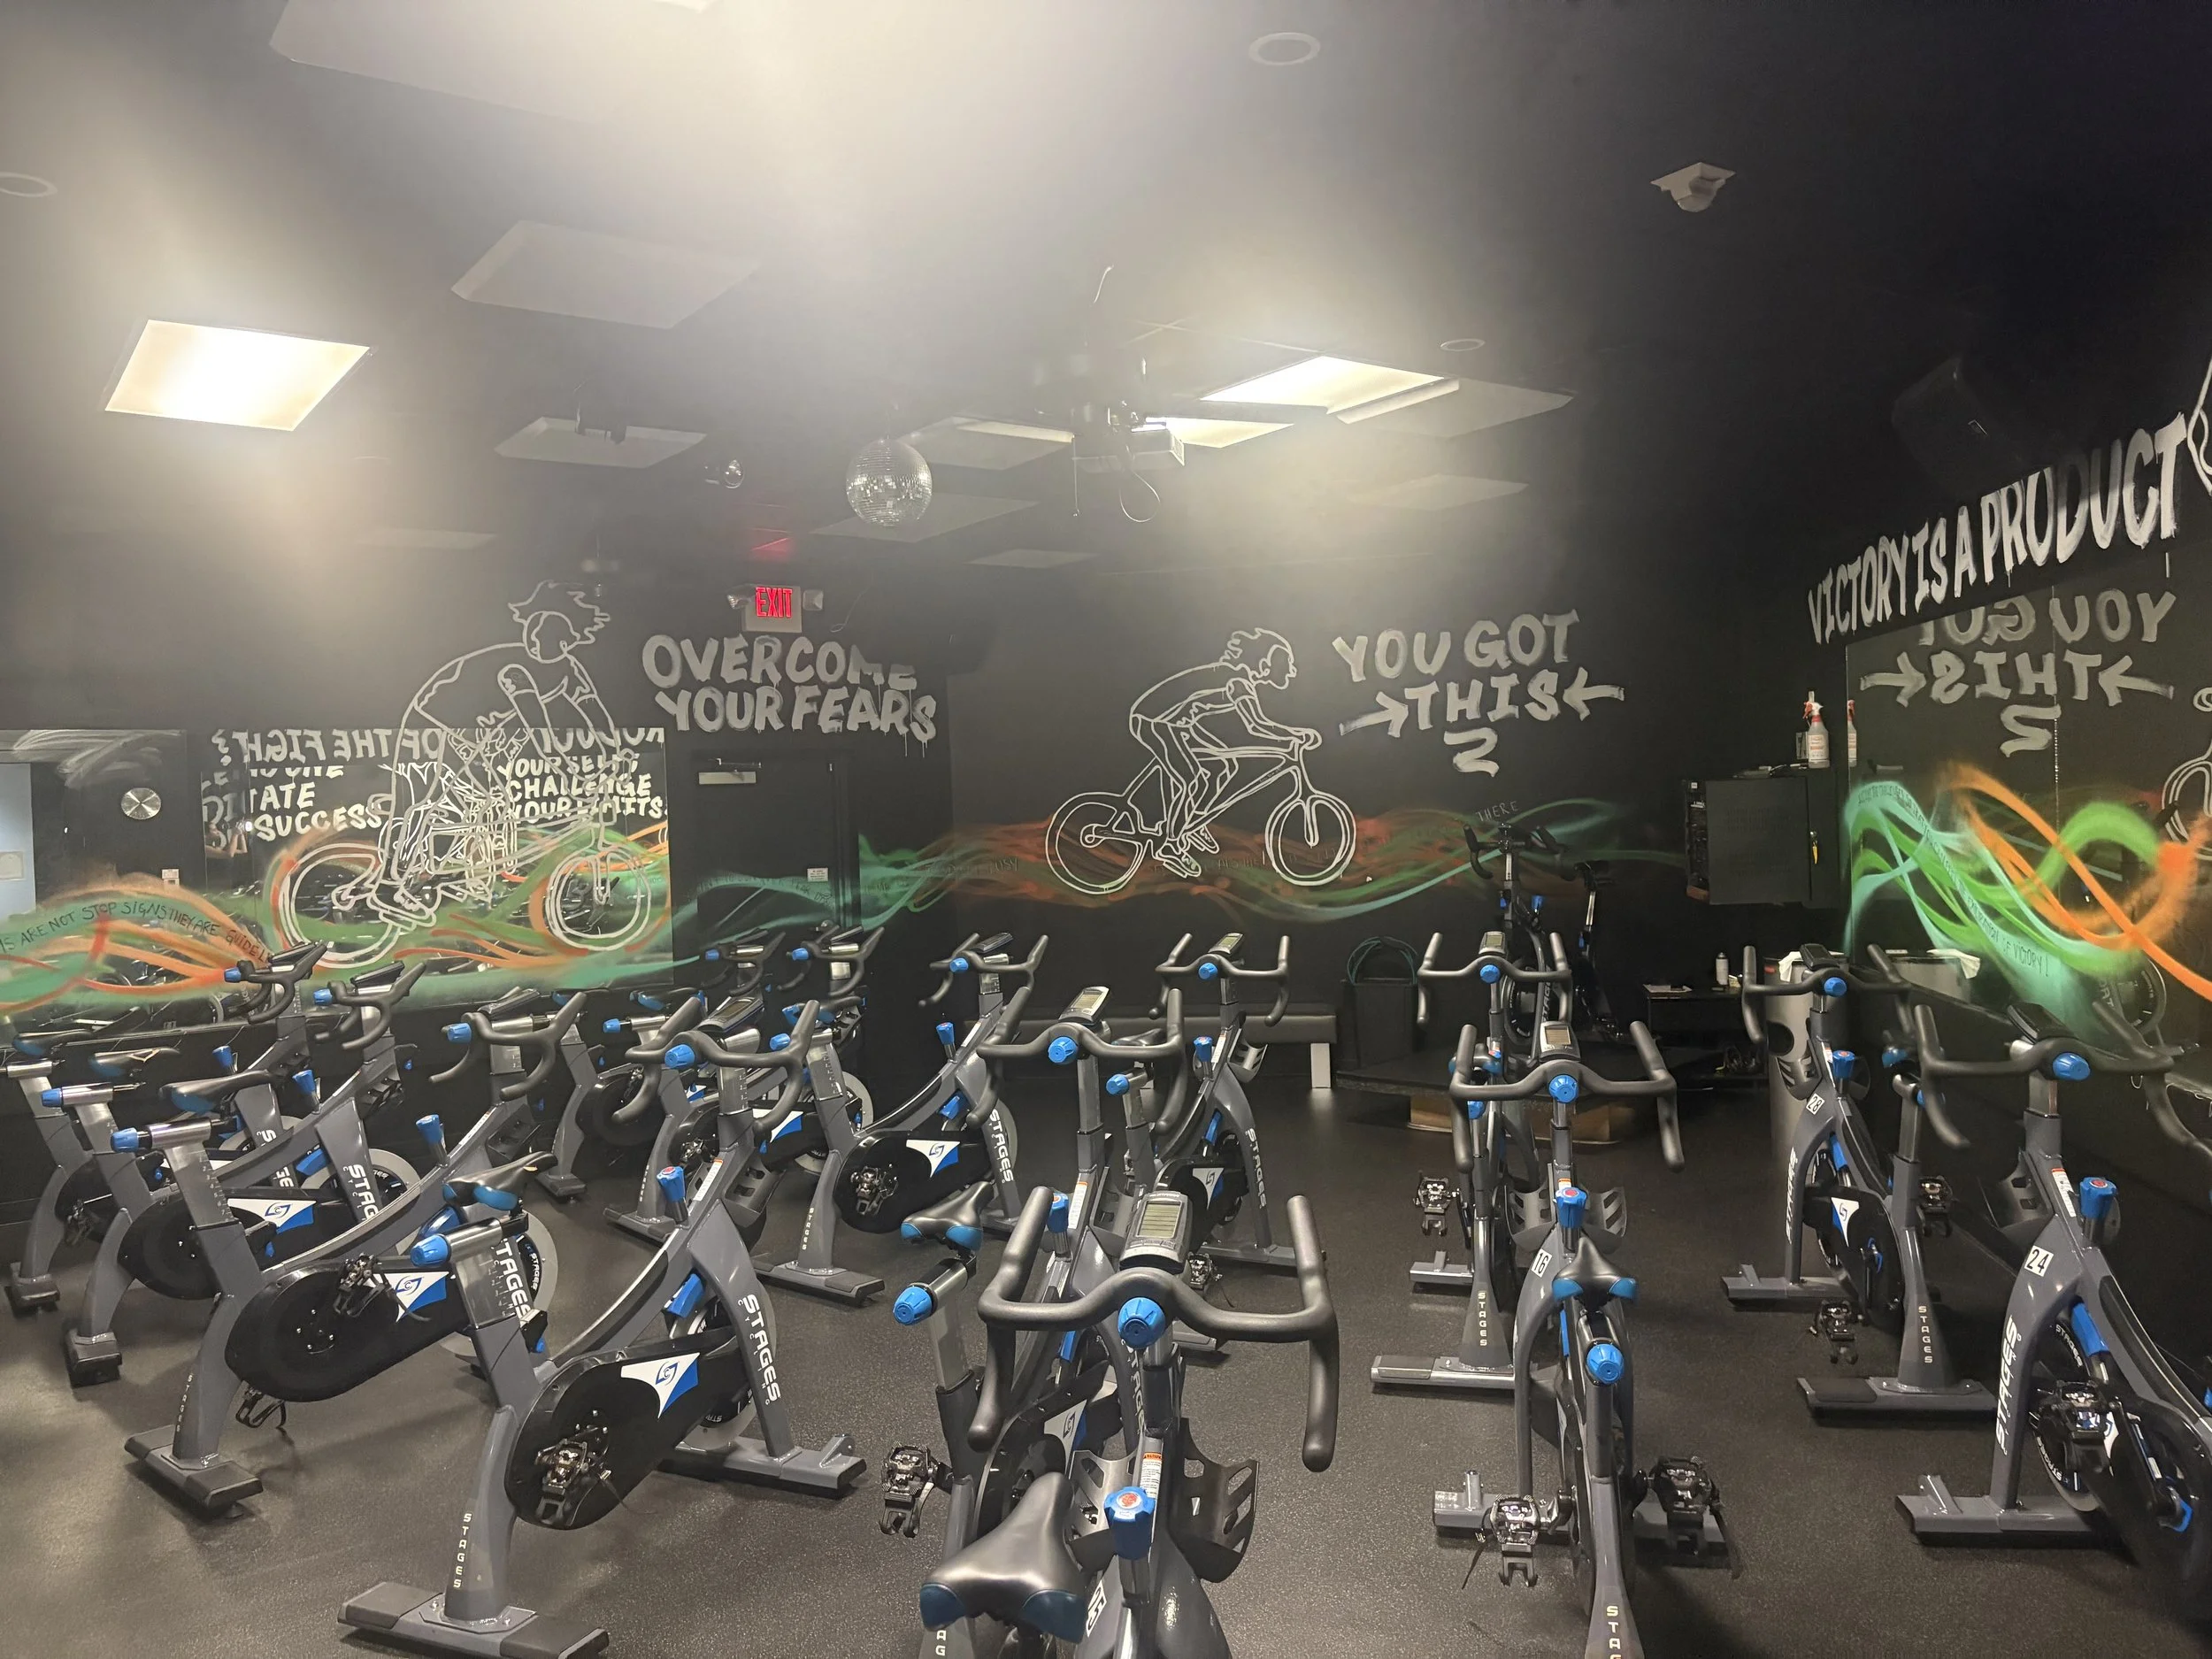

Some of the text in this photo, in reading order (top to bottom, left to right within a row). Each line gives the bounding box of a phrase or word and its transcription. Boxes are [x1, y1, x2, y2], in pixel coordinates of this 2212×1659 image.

[1808, 411, 2186, 644] VICTORY IS A PRODUCT
[756, 587, 793, 618] EXIT
[642, 634, 918, 690] OVERCOME
[1333, 610, 1579, 682] YOU GOT
[655, 685, 937, 743] YOUR FEARS
[1404, 669, 1560, 730] THIS
[254, 804, 382, 841] SUCCESS
[21, 924, 49, 946] ARE
[49, 912, 75, 931] NOT
[82, 902, 117, 920] STOP
[1809, 1095, 1823, 1112] 28
[990, 1109, 1014, 1182] STAGES
[1534, 1252, 1548, 1274] 16
[2026, 1248, 2051, 1274] 24
[743, 1294, 781, 1402] STAGES
[1478, 1291, 1487, 1347] STAGES
[1918, 1305, 1933, 1363] STAGES
[1996, 1315, 2017, 1450] STAGES
[454, 1513, 472, 1589] STAGES
